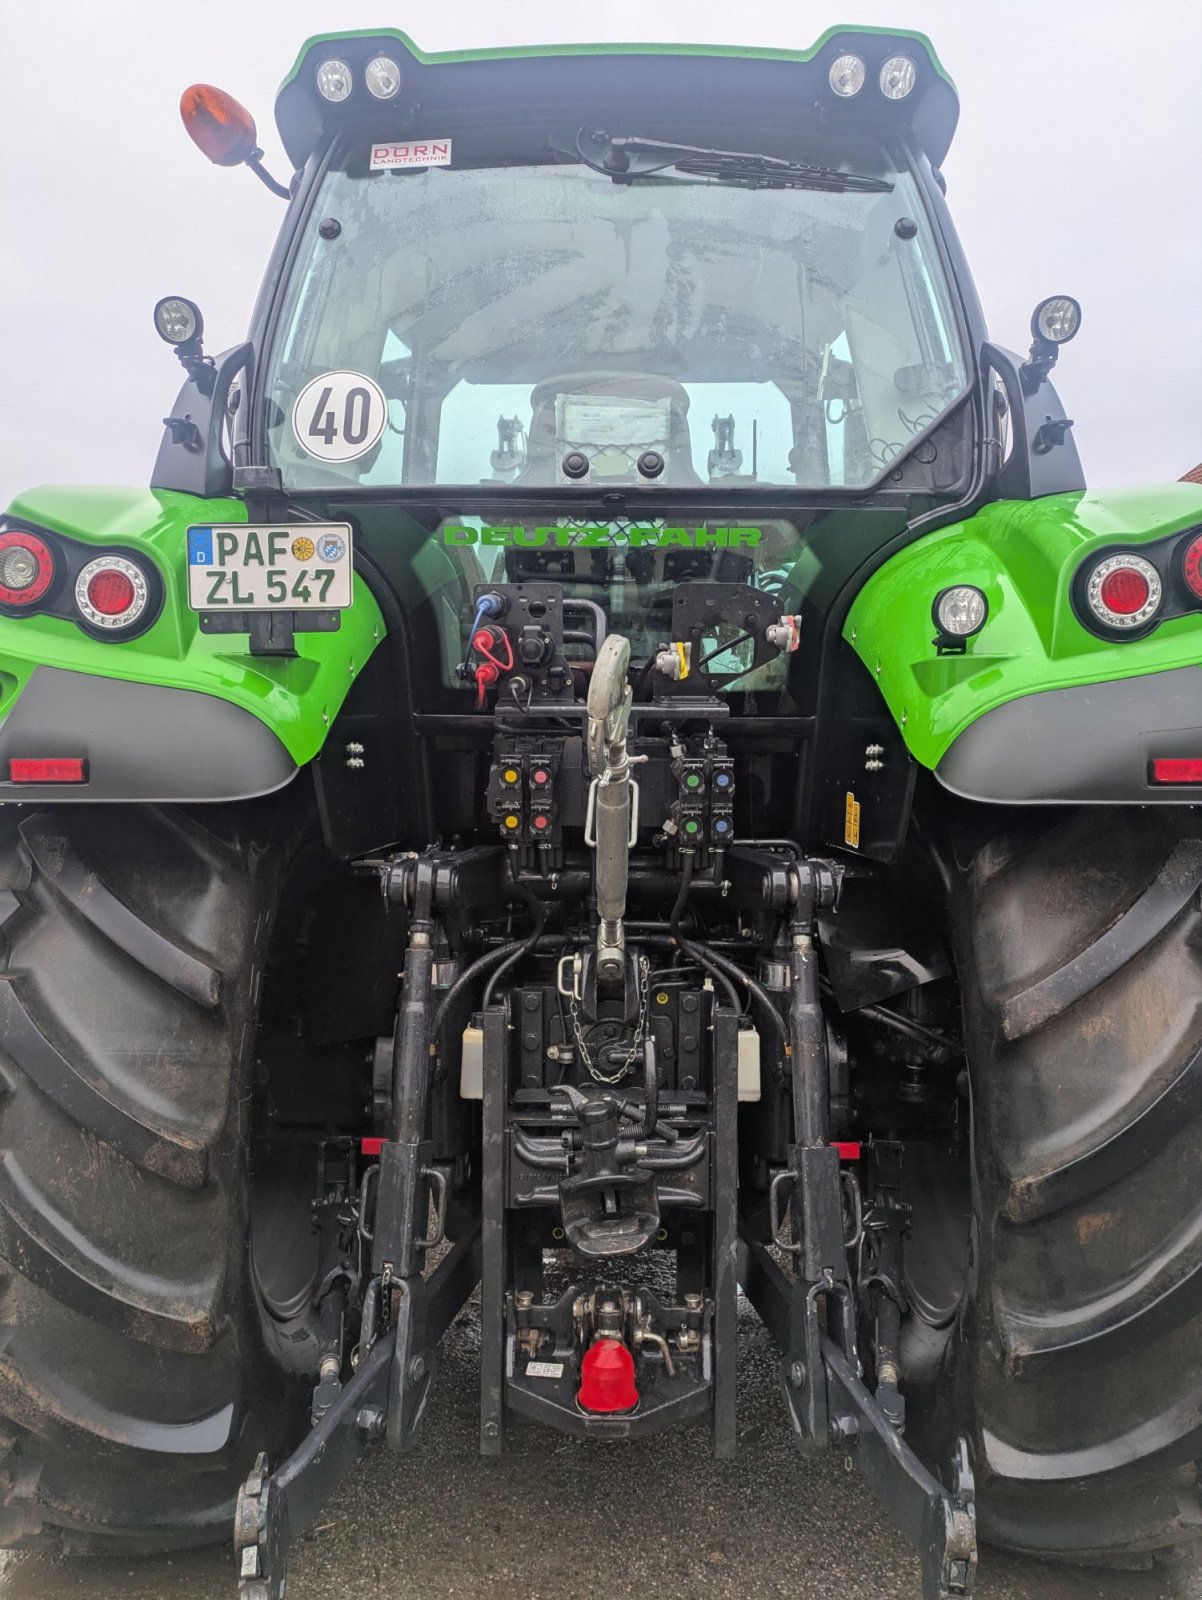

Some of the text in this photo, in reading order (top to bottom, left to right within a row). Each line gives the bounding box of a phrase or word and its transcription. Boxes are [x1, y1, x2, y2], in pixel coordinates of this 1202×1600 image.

[373, 156, 448, 165] LANDTECHNIK
[308, 386, 371, 445] 40
[216, 531, 290, 566] PAF
[443, 526, 762, 548] DEUTZ-FAHR
[196, 551, 206, 563] D
[206, 569, 335, 604] ZL 547
